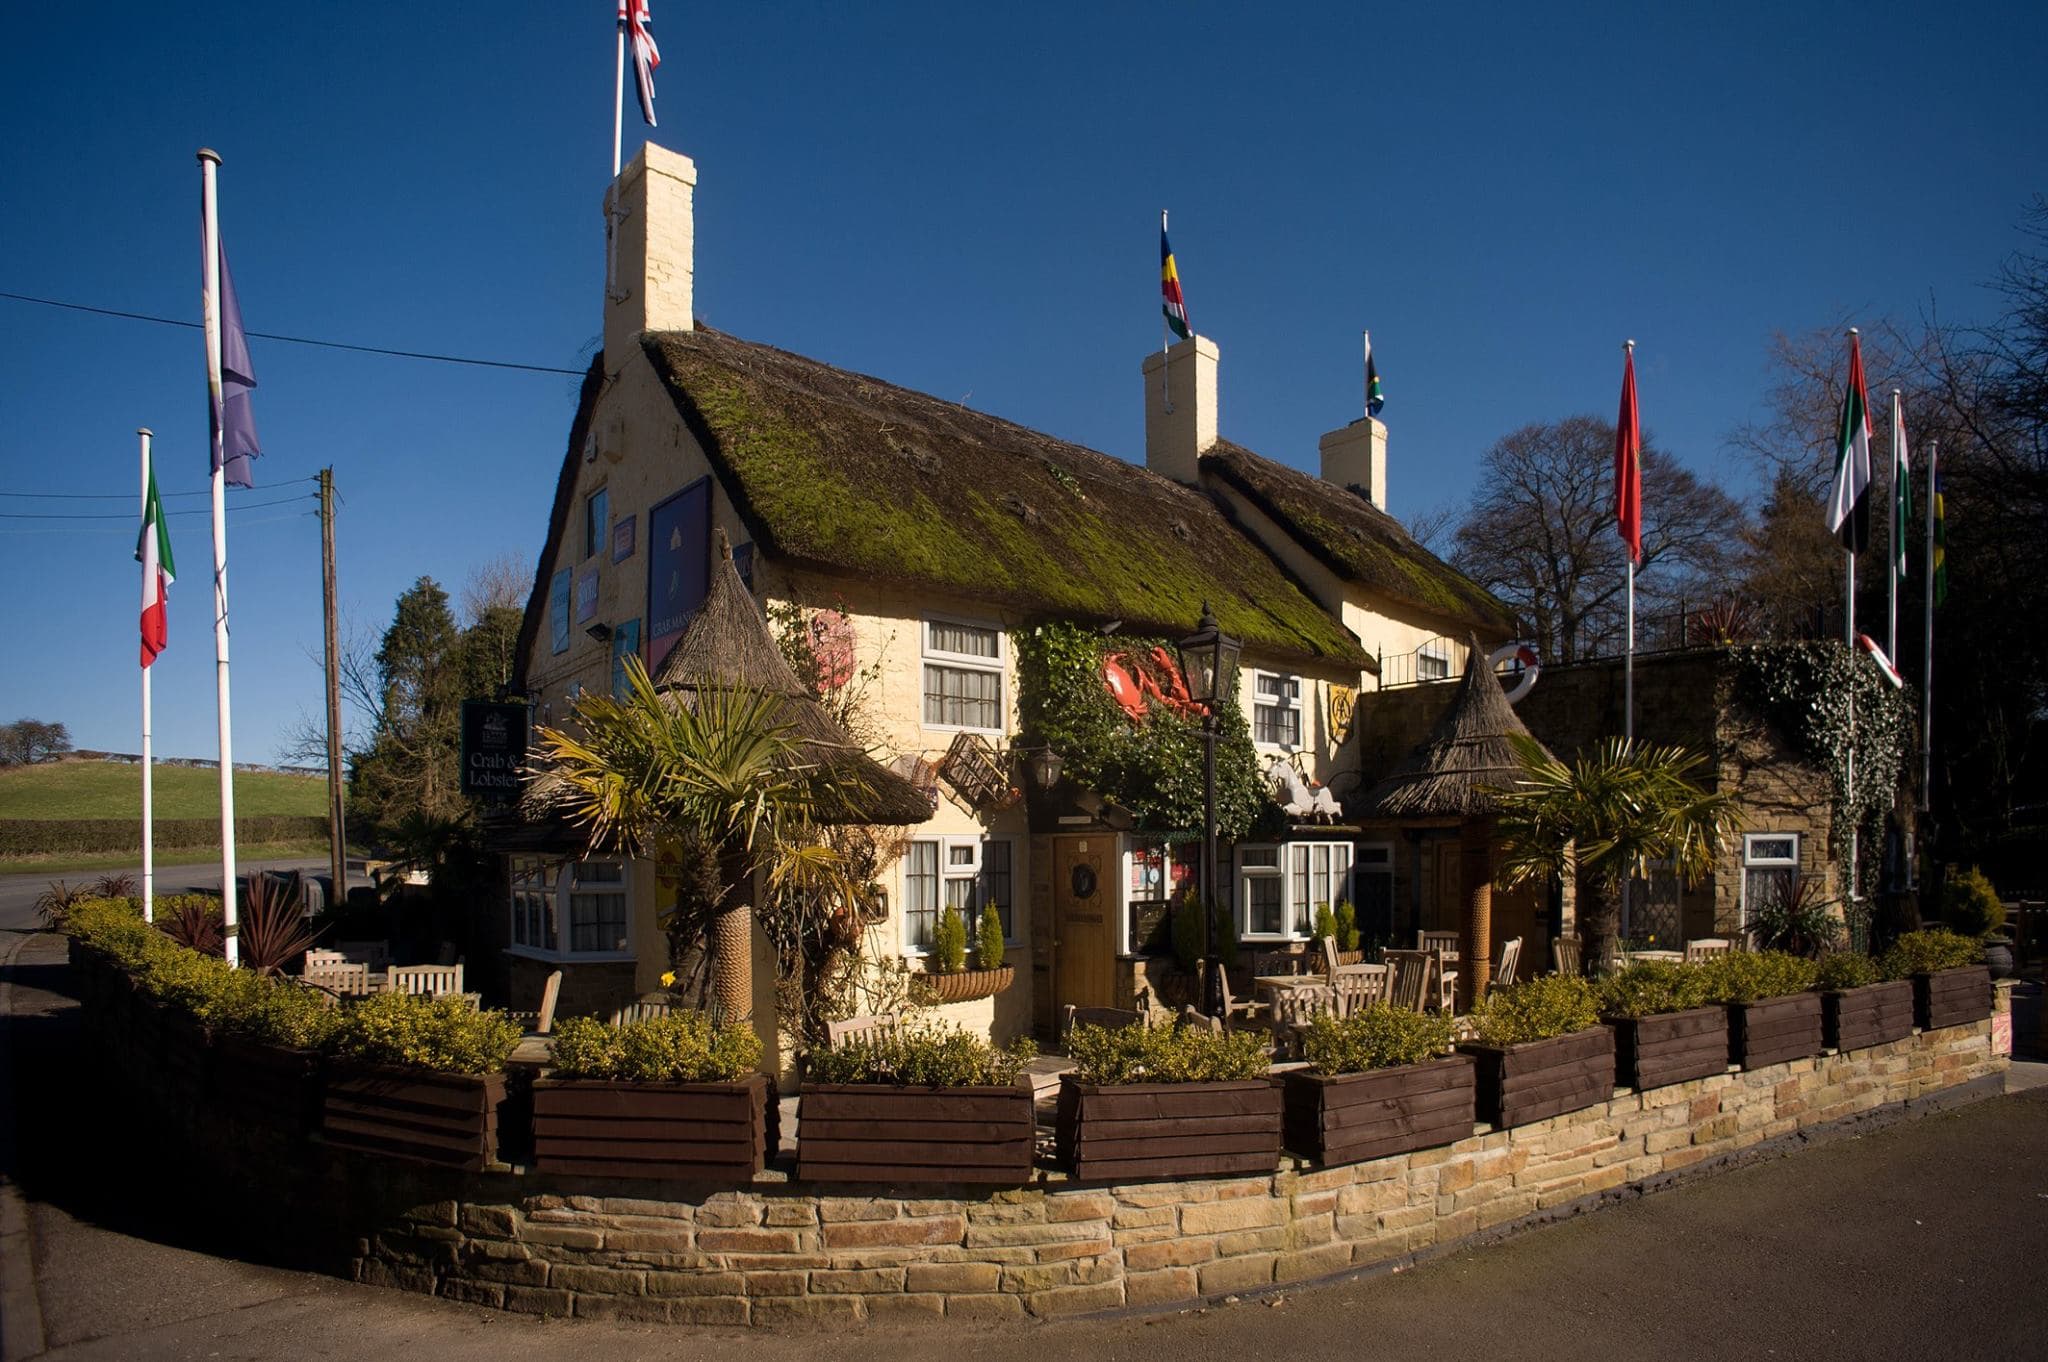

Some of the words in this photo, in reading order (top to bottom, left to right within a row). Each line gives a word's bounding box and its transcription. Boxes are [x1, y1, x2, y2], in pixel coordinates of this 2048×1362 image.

[471, 752, 505, 769] Crab
[507, 753, 518, 769] &
[470, 770, 518, 788] Lobster
